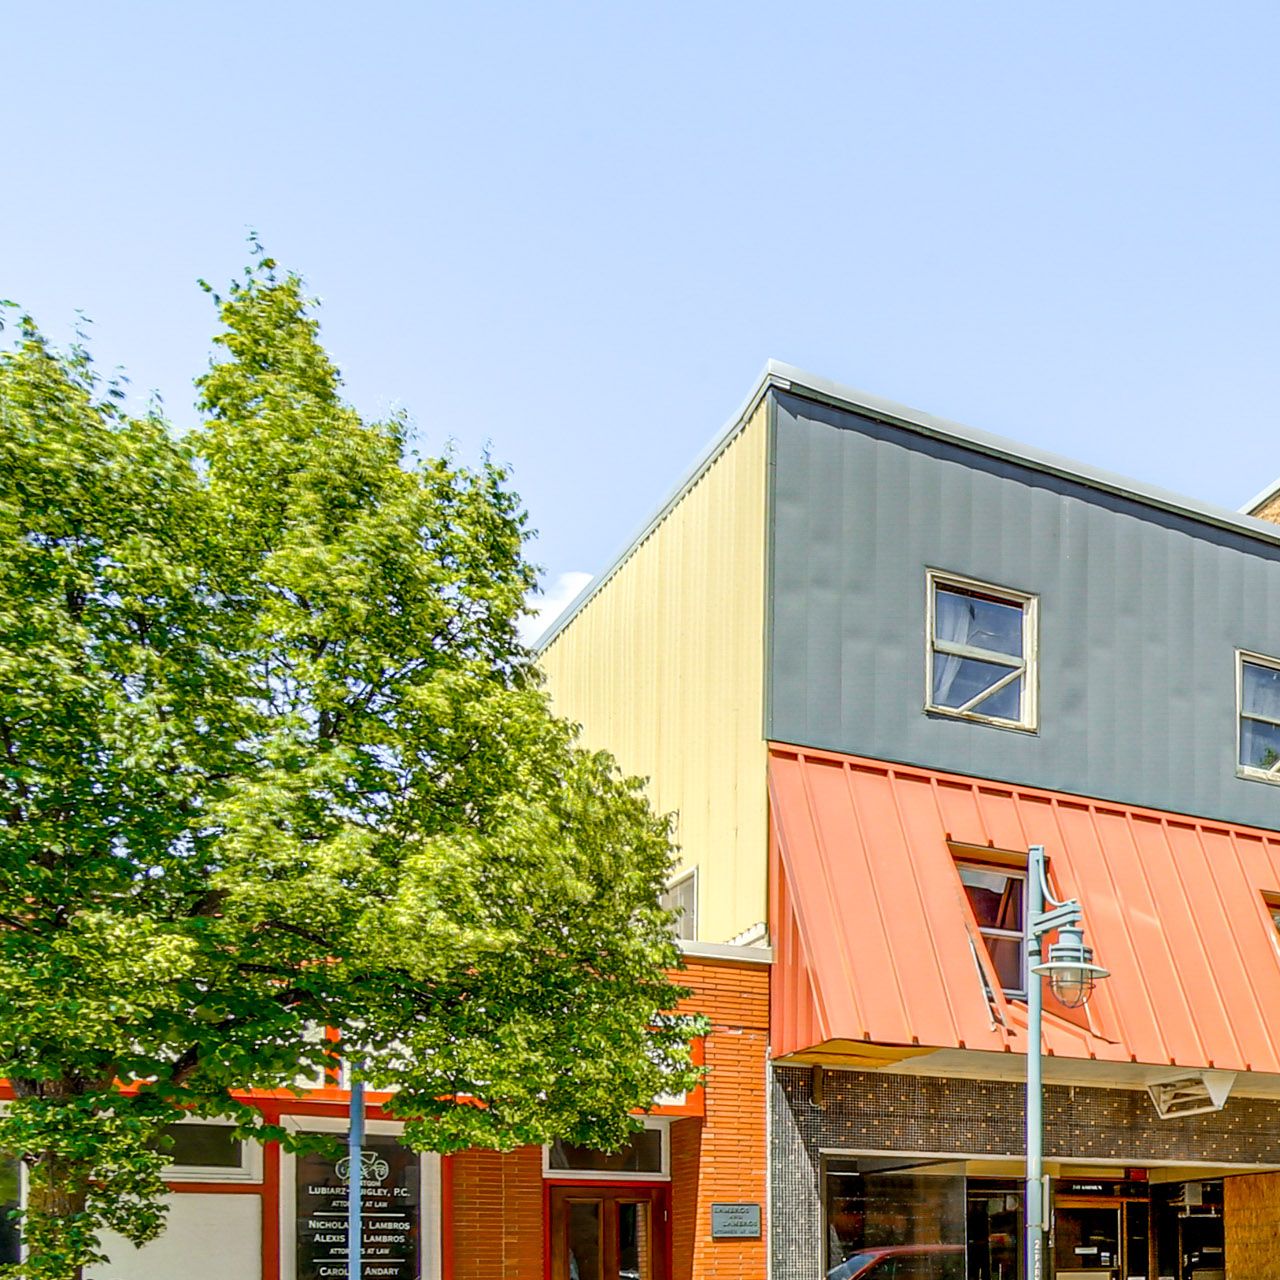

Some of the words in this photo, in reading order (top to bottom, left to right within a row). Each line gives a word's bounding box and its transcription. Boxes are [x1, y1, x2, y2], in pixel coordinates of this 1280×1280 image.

[308, 1220, 351, 1229] NICHOLA
[368, 1221, 411, 1231] LAMBROS
[313, 1234, 346, 1243] ALEXIS
[363, 1234, 406, 1243] LAMBROS
[364, 1267, 400, 1276] ANDARY
